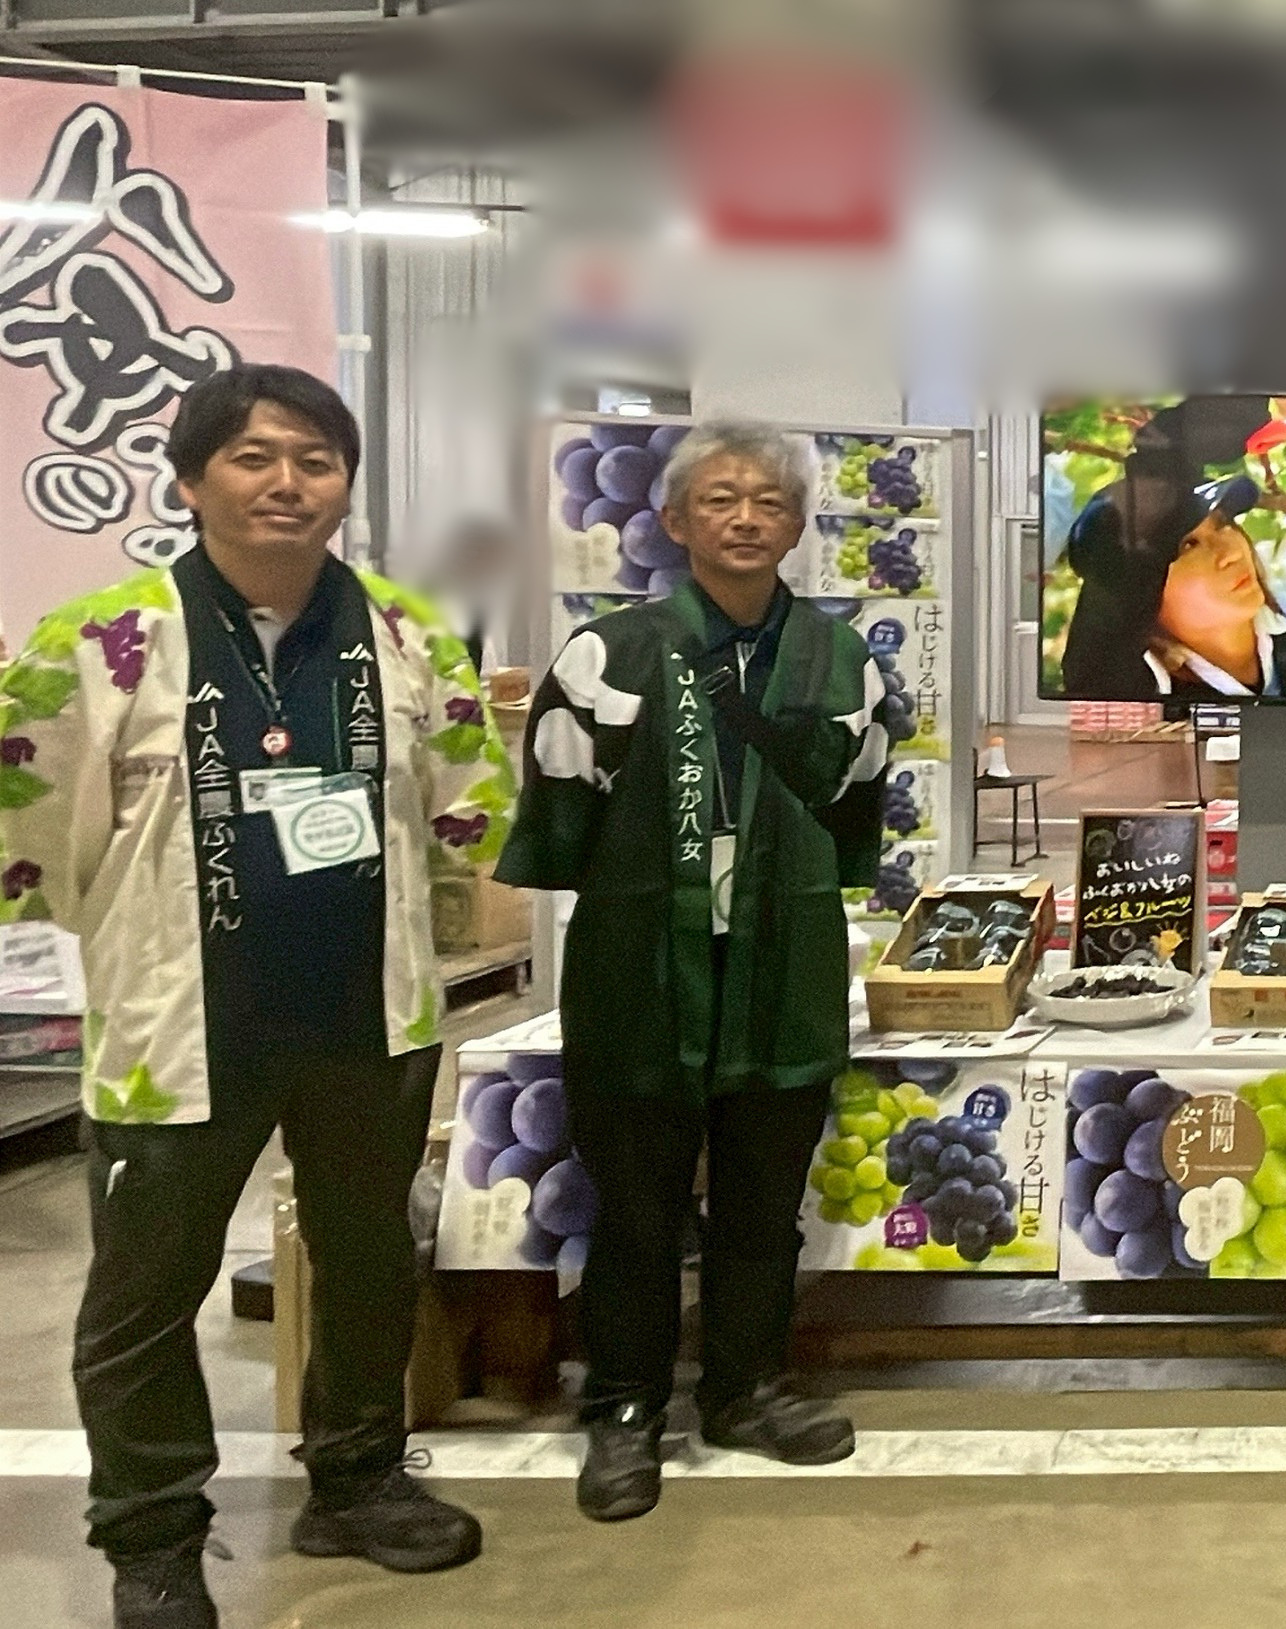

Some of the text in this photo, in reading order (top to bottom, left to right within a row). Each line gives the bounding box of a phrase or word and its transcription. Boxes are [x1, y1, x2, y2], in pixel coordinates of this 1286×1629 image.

[675, 669, 704, 862] JAふくおか八女
[1019, 1068, 1056, 1238] はじける甘さ
[1171, 1103, 1203, 1182] ぶどう
[1210, 1097, 1236, 1153] 福岡
